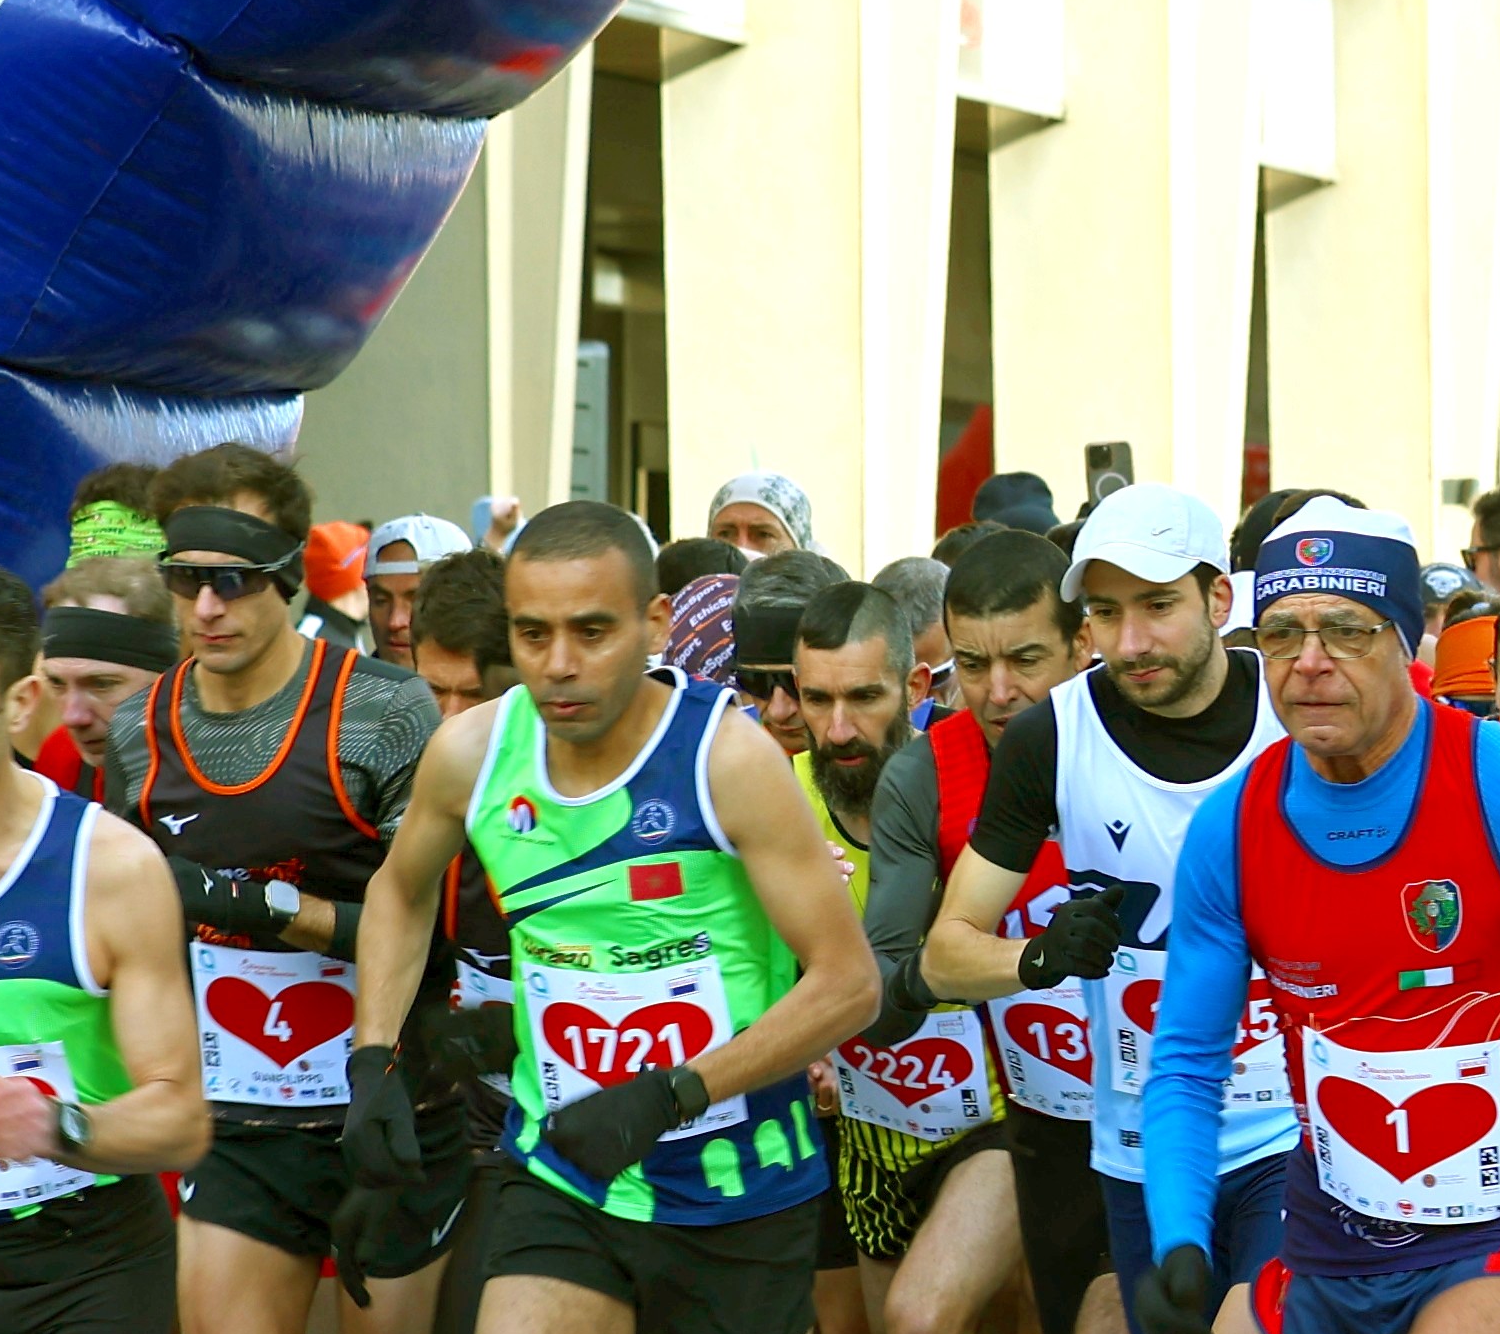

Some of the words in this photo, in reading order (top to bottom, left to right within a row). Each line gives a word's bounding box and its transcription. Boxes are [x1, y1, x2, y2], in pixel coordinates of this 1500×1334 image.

[1257, 576, 1387, 600] CARABINIERI
[1326, 828, 1375, 842] CRAFT
[607, 930, 712, 971] Sagres
[262, 1001, 294, 1043] 4
[563, 1022, 687, 1073] 1721
[853, 1044, 956, 1090] 2224
[1385, 1109, 1410, 1153] 1
